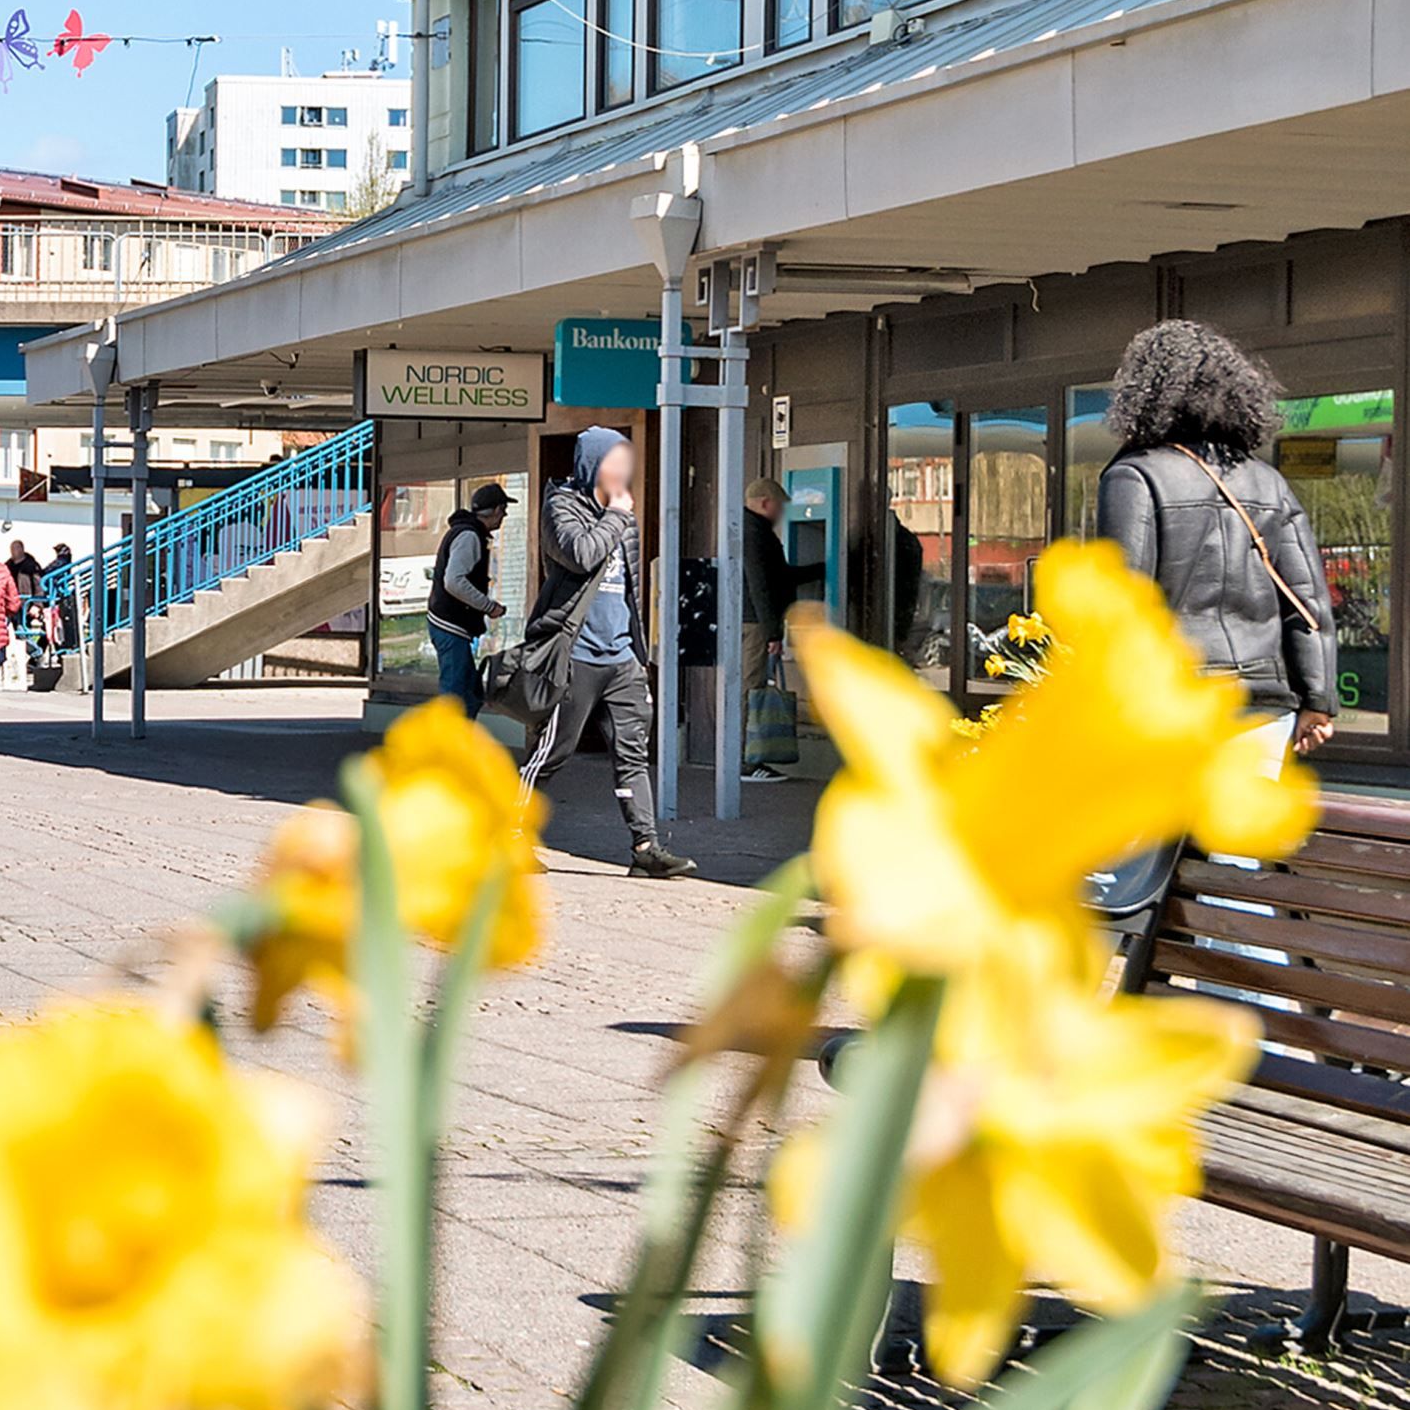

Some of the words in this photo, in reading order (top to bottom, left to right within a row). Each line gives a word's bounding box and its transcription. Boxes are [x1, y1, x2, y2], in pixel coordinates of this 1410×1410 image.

[571, 326, 661, 351] Bankom
[406, 365, 504, 385] NORDIC
[381, 385, 529, 407] WELLNESS
